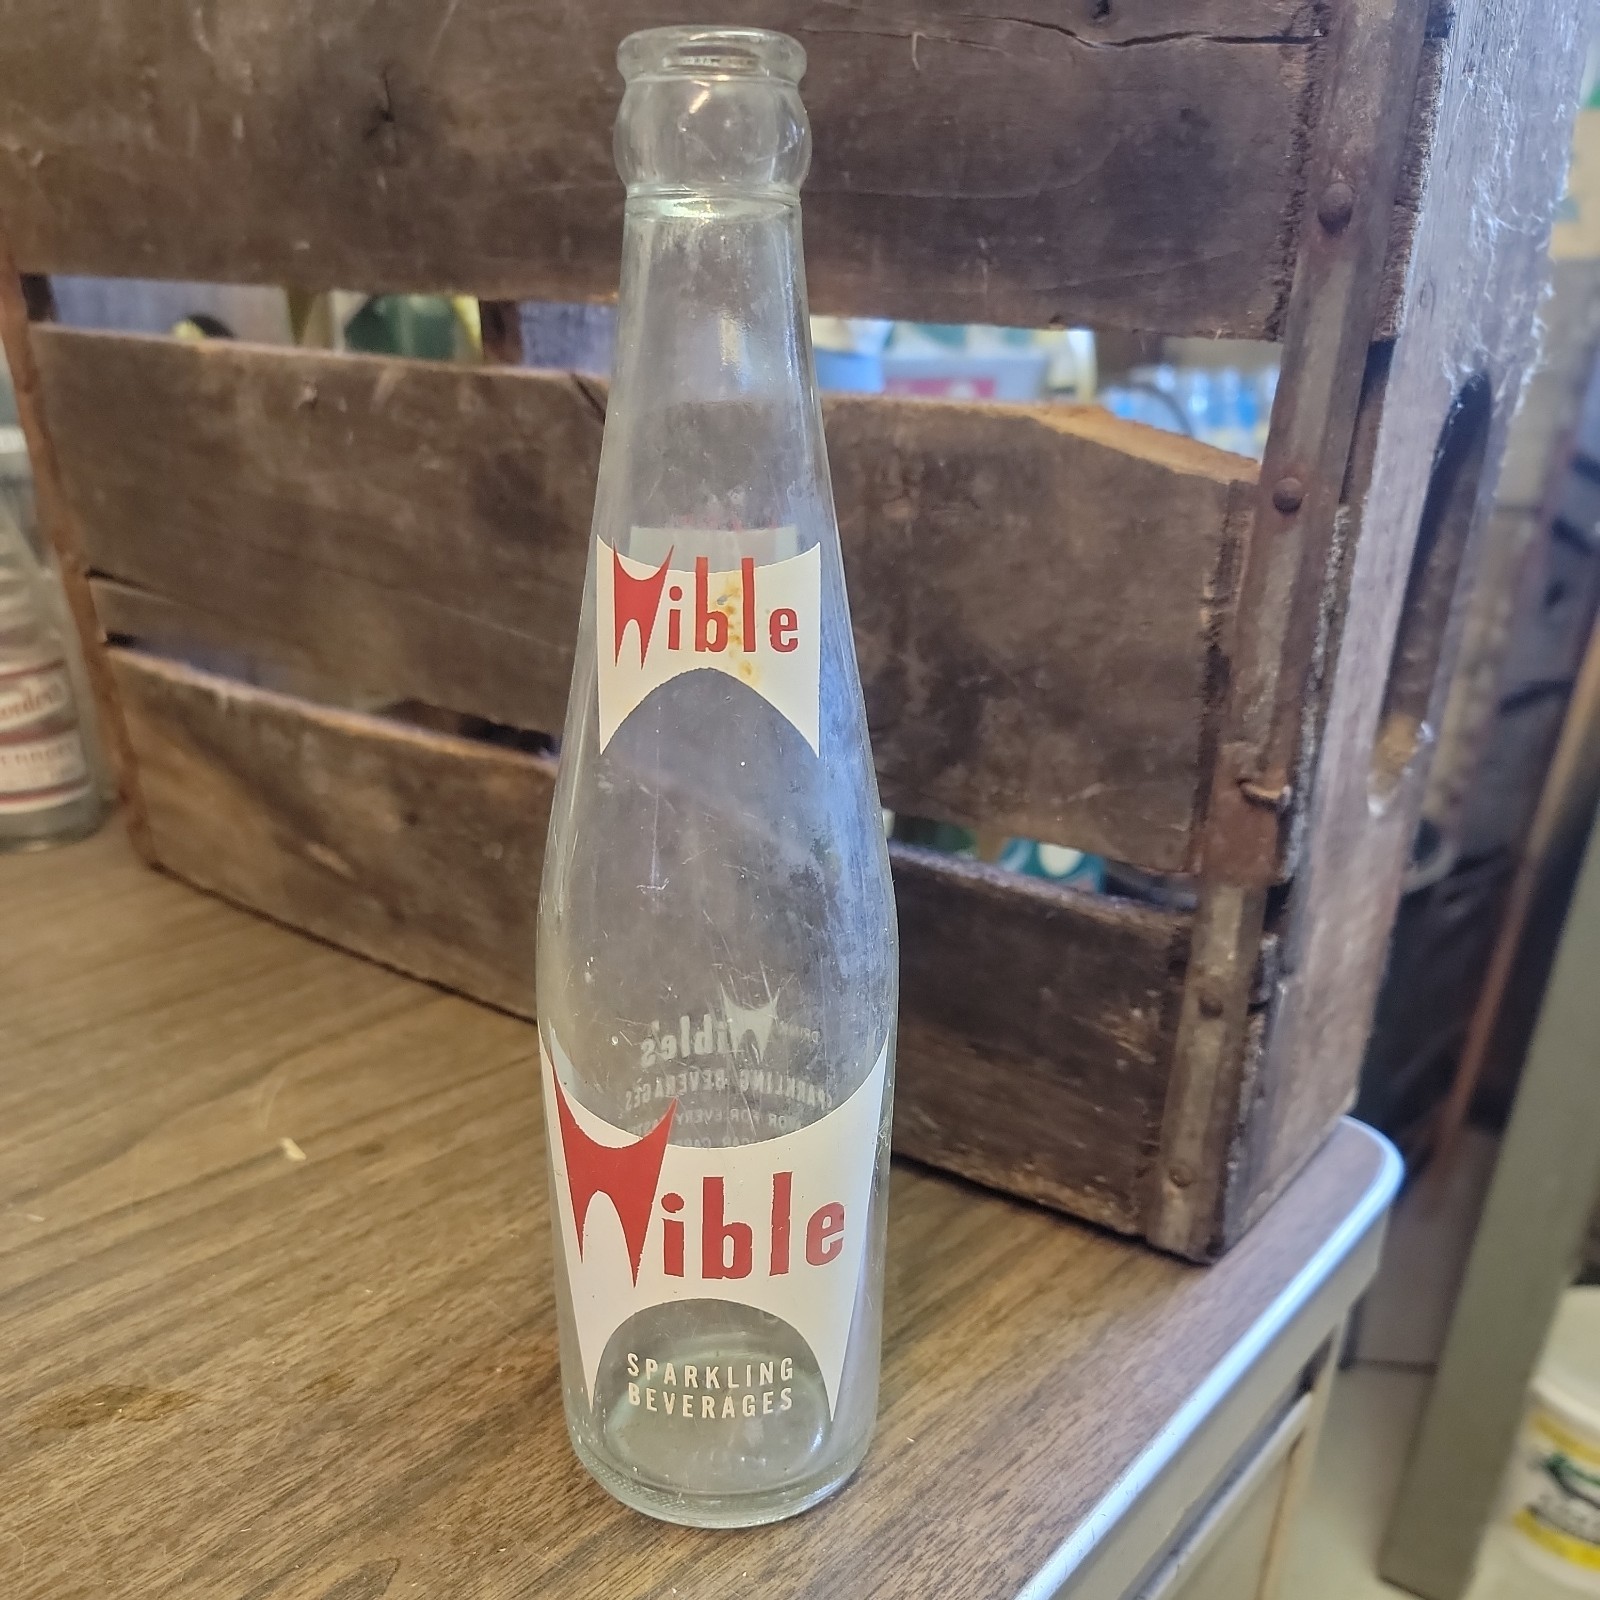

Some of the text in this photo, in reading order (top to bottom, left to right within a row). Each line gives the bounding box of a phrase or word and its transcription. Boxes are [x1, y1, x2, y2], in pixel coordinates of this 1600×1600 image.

[612, 538, 799, 671] Wible
[551, 1042, 844, 1288] Wible
[626, 1352, 794, 1389] SPARKLING
[627, 1382, 794, 1419] BEVERAGES
